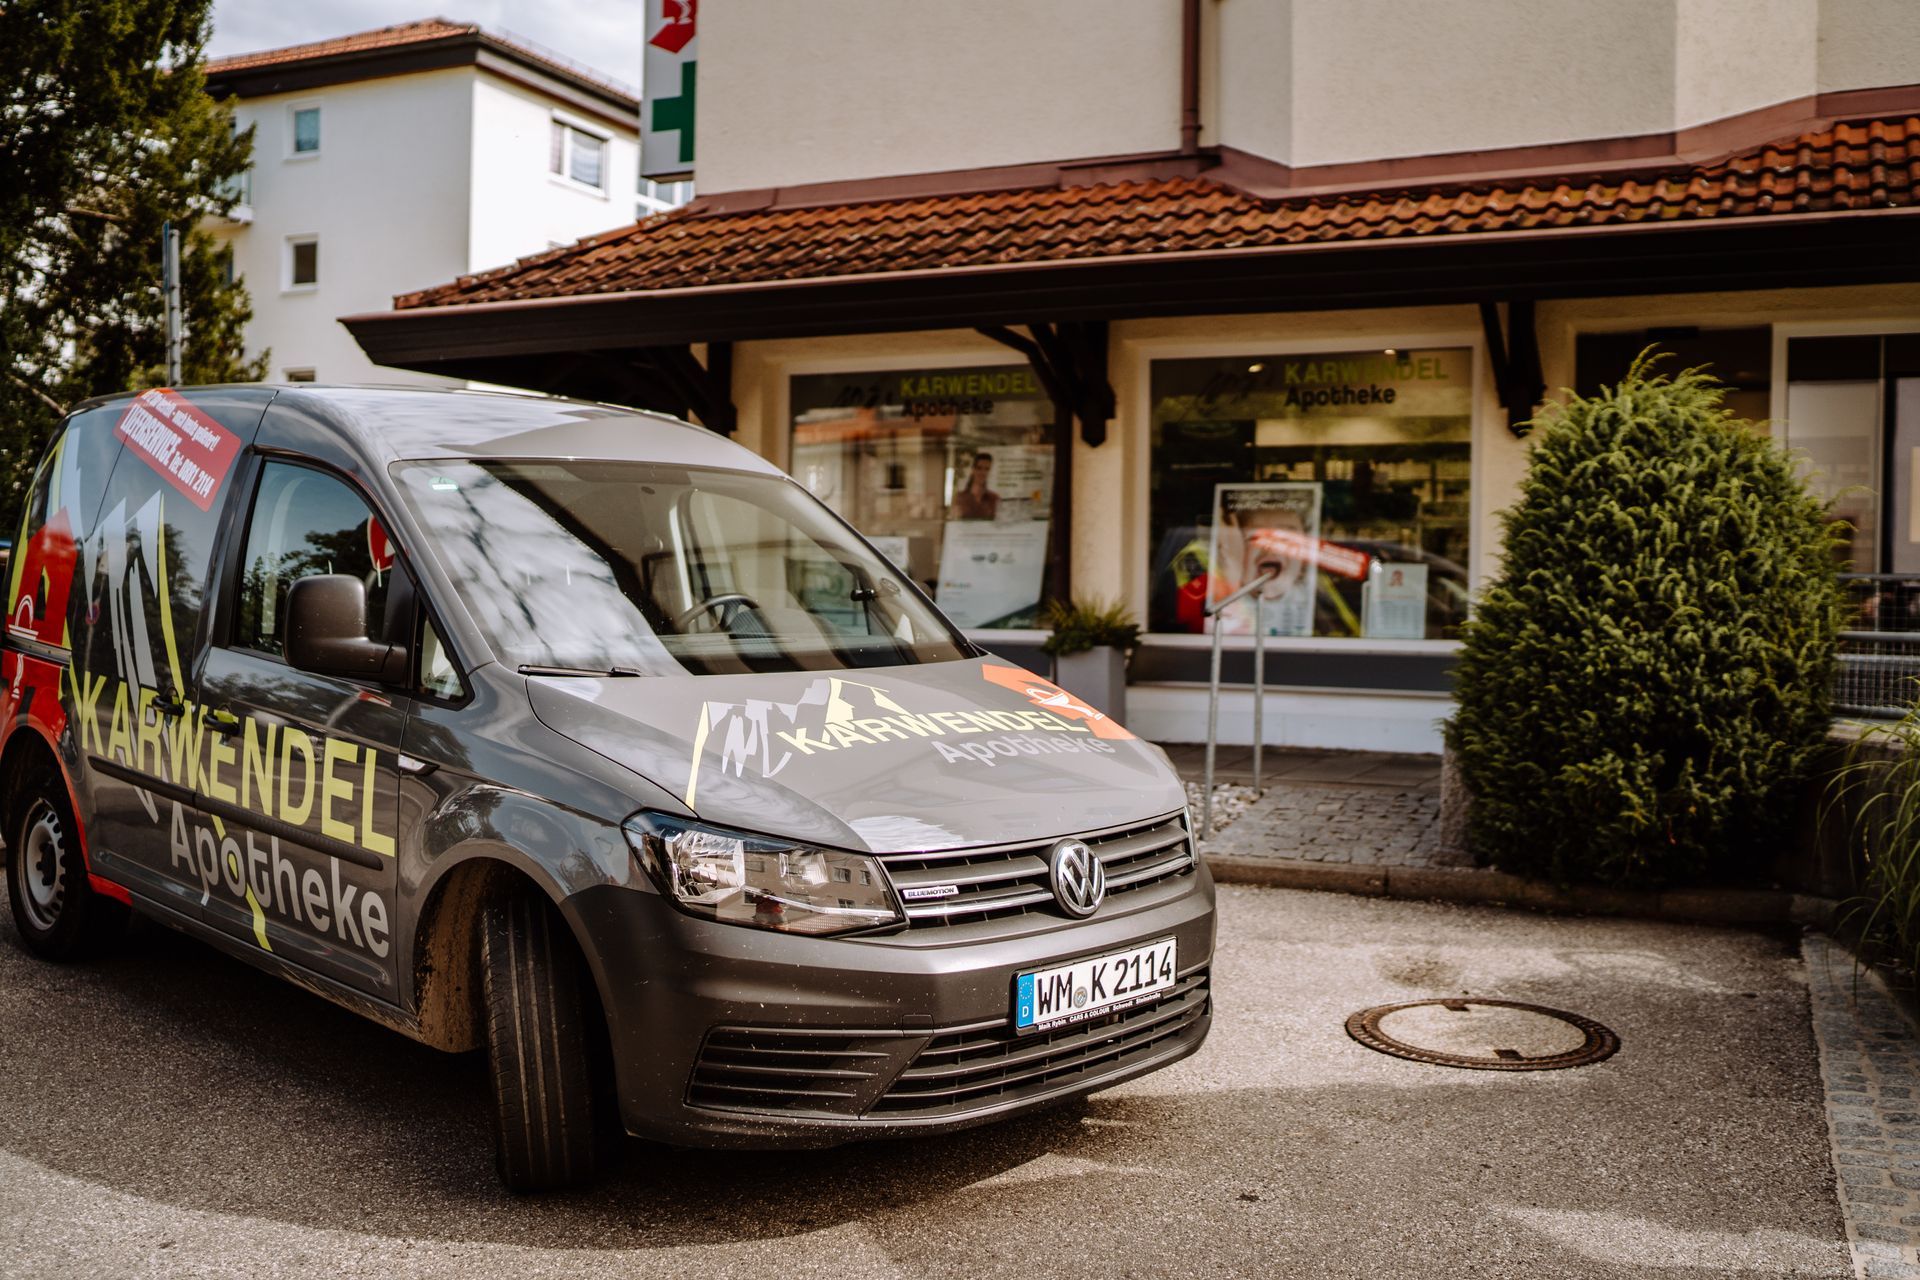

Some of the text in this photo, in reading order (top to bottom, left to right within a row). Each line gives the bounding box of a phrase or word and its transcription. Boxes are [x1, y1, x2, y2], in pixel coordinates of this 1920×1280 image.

[900, 372, 1037, 397] KARWENDEL
[1285, 358, 1449, 384] KARWENDEL
[901, 396, 995, 422] Apotheke
[1284, 384, 1397, 412] Apotheke
[120, 403, 182, 467] LIEFERSERVICE
[192, 470, 216, 499] 2114
[776, 709, 1091, 756] KARWENDEL
[81, 671, 395, 857] KARWENDEL
[931, 731, 1117, 767] Apotheke
[170, 798, 390, 959] Apotheke
[1037, 945, 1172, 1016] WM K 2114
[1021, 1005, 1029, 1018] D
[1089, 1006, 1110, 1018] COLOUR
